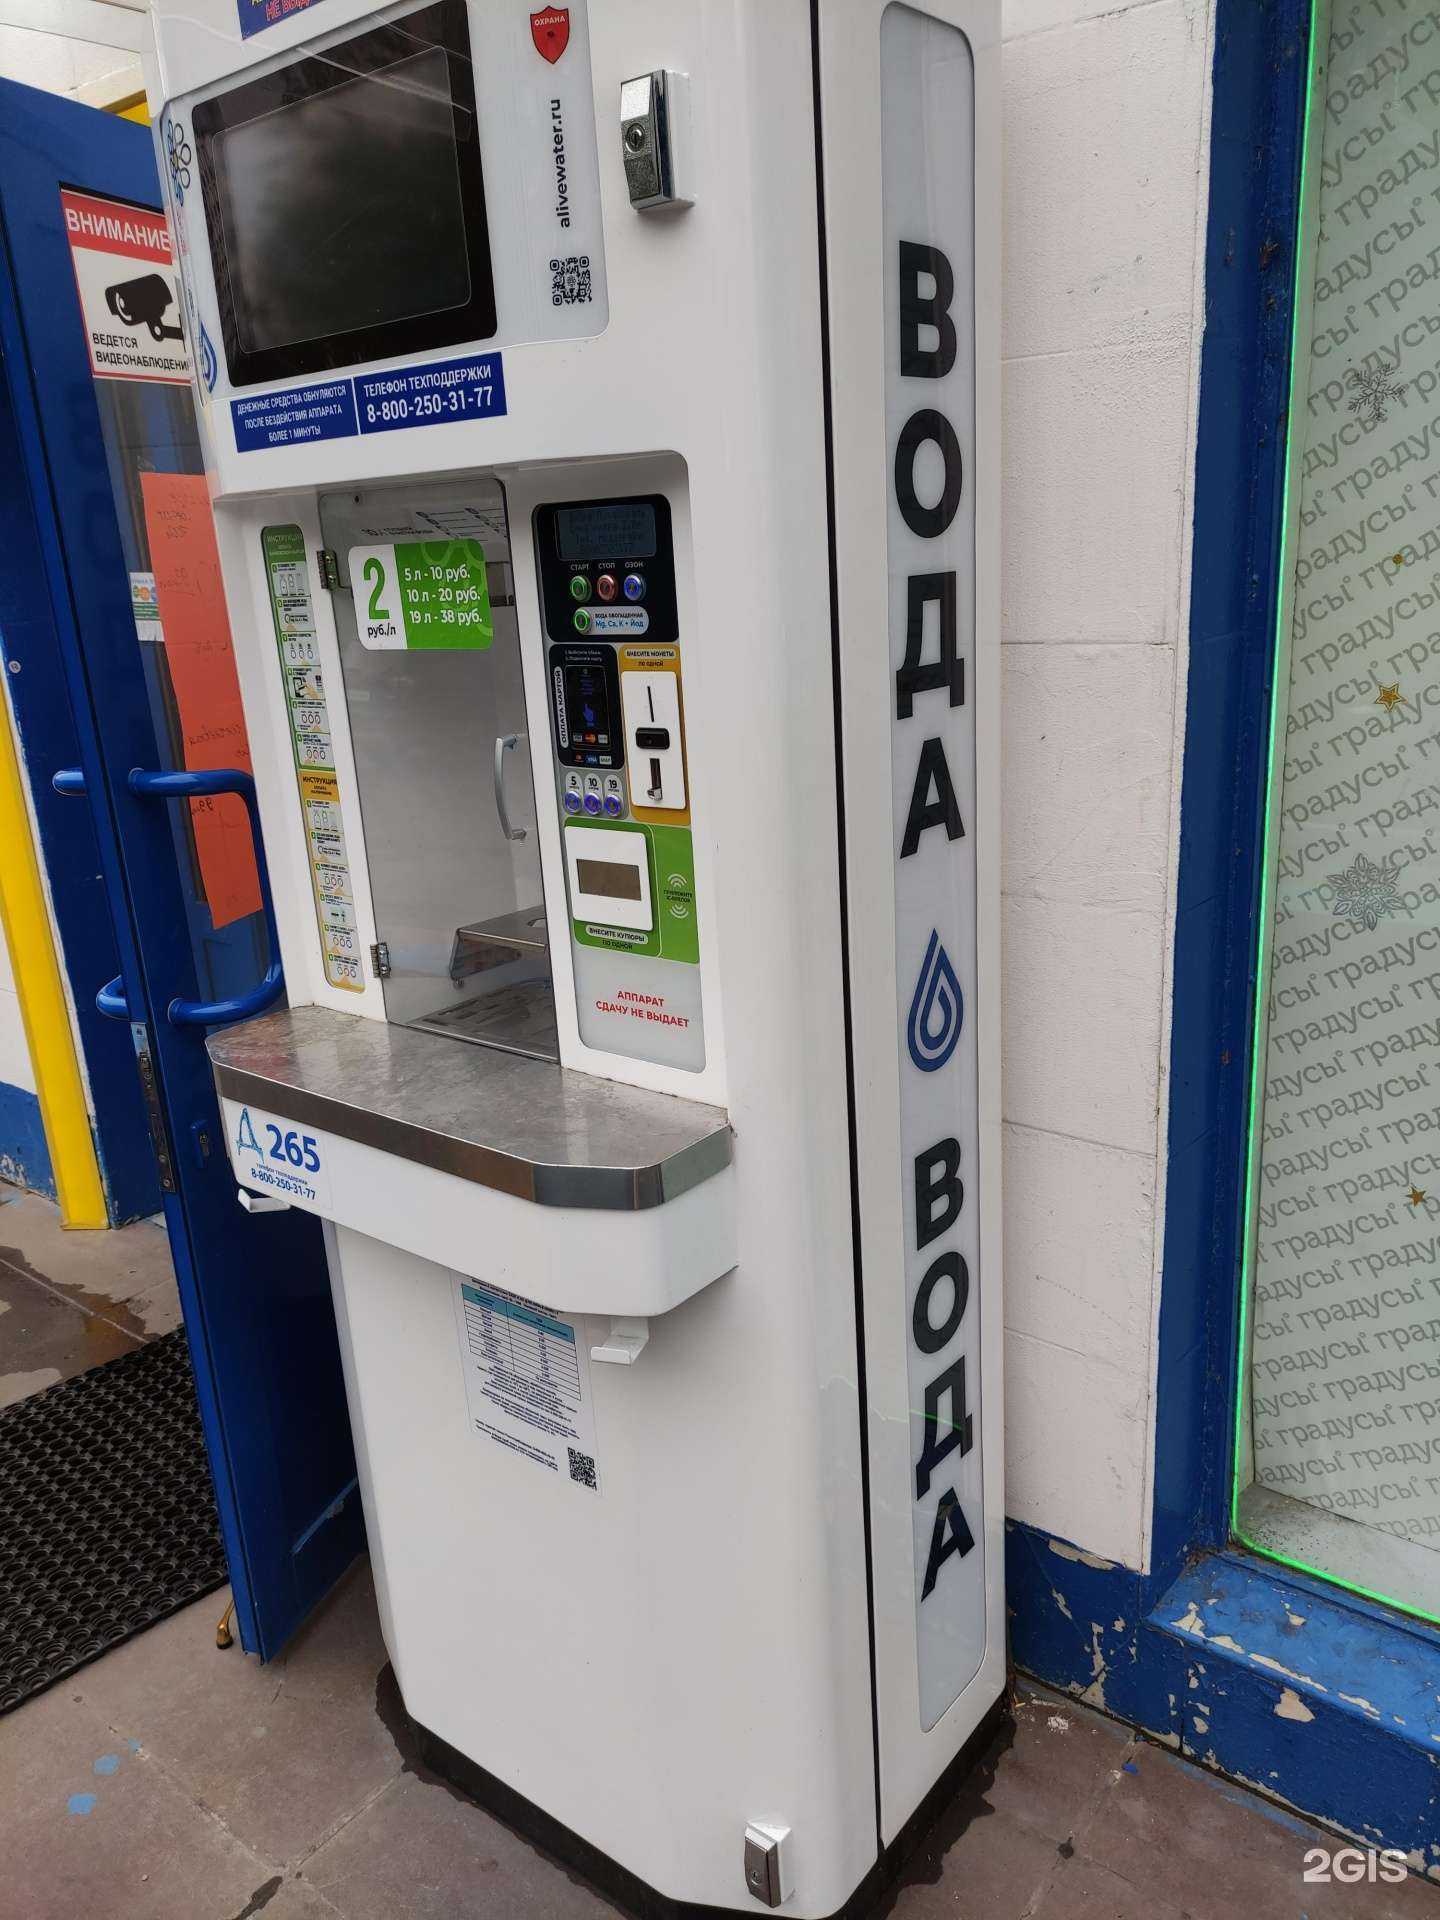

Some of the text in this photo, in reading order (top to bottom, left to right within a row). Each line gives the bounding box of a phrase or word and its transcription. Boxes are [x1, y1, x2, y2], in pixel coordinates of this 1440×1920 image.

[534, 15, 565, 27] ОХРАНА
[550, 99, 571, 229] alivewater.ru
[65, 207, 171, 252] ВНИМАНИЕ
[92, 332, 138, 349] ВЕДЕТСЯ
[363, 365, 492, 398] ТЕЛЕФОН ТЕХПОДДЕРЖКИ
[237, 385, 347, 416] ДЕНЕЖНЫЕ СРЕДСТВА ОБНУЛЯЮТСЯ
[367, 386, 493, 423] 8-800-250-31-77
[244, 404, 343, 429] ПОСЛЕ БЕЗДЕЙСТВИЯ АППАРАТА
[268, 430, 288, 442] БОЛЕЕ
[293, 425, 321, 439] МИНУТЫ
[404, 568, 412, 582] 5
[413, 571, 422, 581] л
[430, 567, 443, 580] 10
[446, 564, 470, 583] руб.
[570, 562, 589, 571] СТАРТ
[363, 557, 390, 620] 2
[408, 589, 419, 602] 10
[422, 591, 430, 602] л
[438, 588, 453, 601] 20
[456, 586, 481, 604] руб.
[409, 610, 420, 624] 19
[422, 612, 431, 624] л
[440, 610, 455, 623] 38
[458, 609, 482, 626] руб.
[367, 625, 397, 638] руб./л
[554, 669, 570, 744] ОПЛАТА КАРТОЙ
[570, 776, 577, 786] 5
[588, 777, 598, 787] 10
[608, 779, 618, 789] 19
[895, 240, 976, 1603] ВОДА ВОДА
[589, 927, 645, 942] ВНЕСИТЕ КУПЮРЫ
[617, 990, 665, 1008] АППАРАТ
[596, 1000, 690, 1028] СДАЧУ НЕ ВЫДАЕТ
[266, 1123, 320, 1173] 265
[251, 1168, 316, 1200] 8-800-250-31-77
